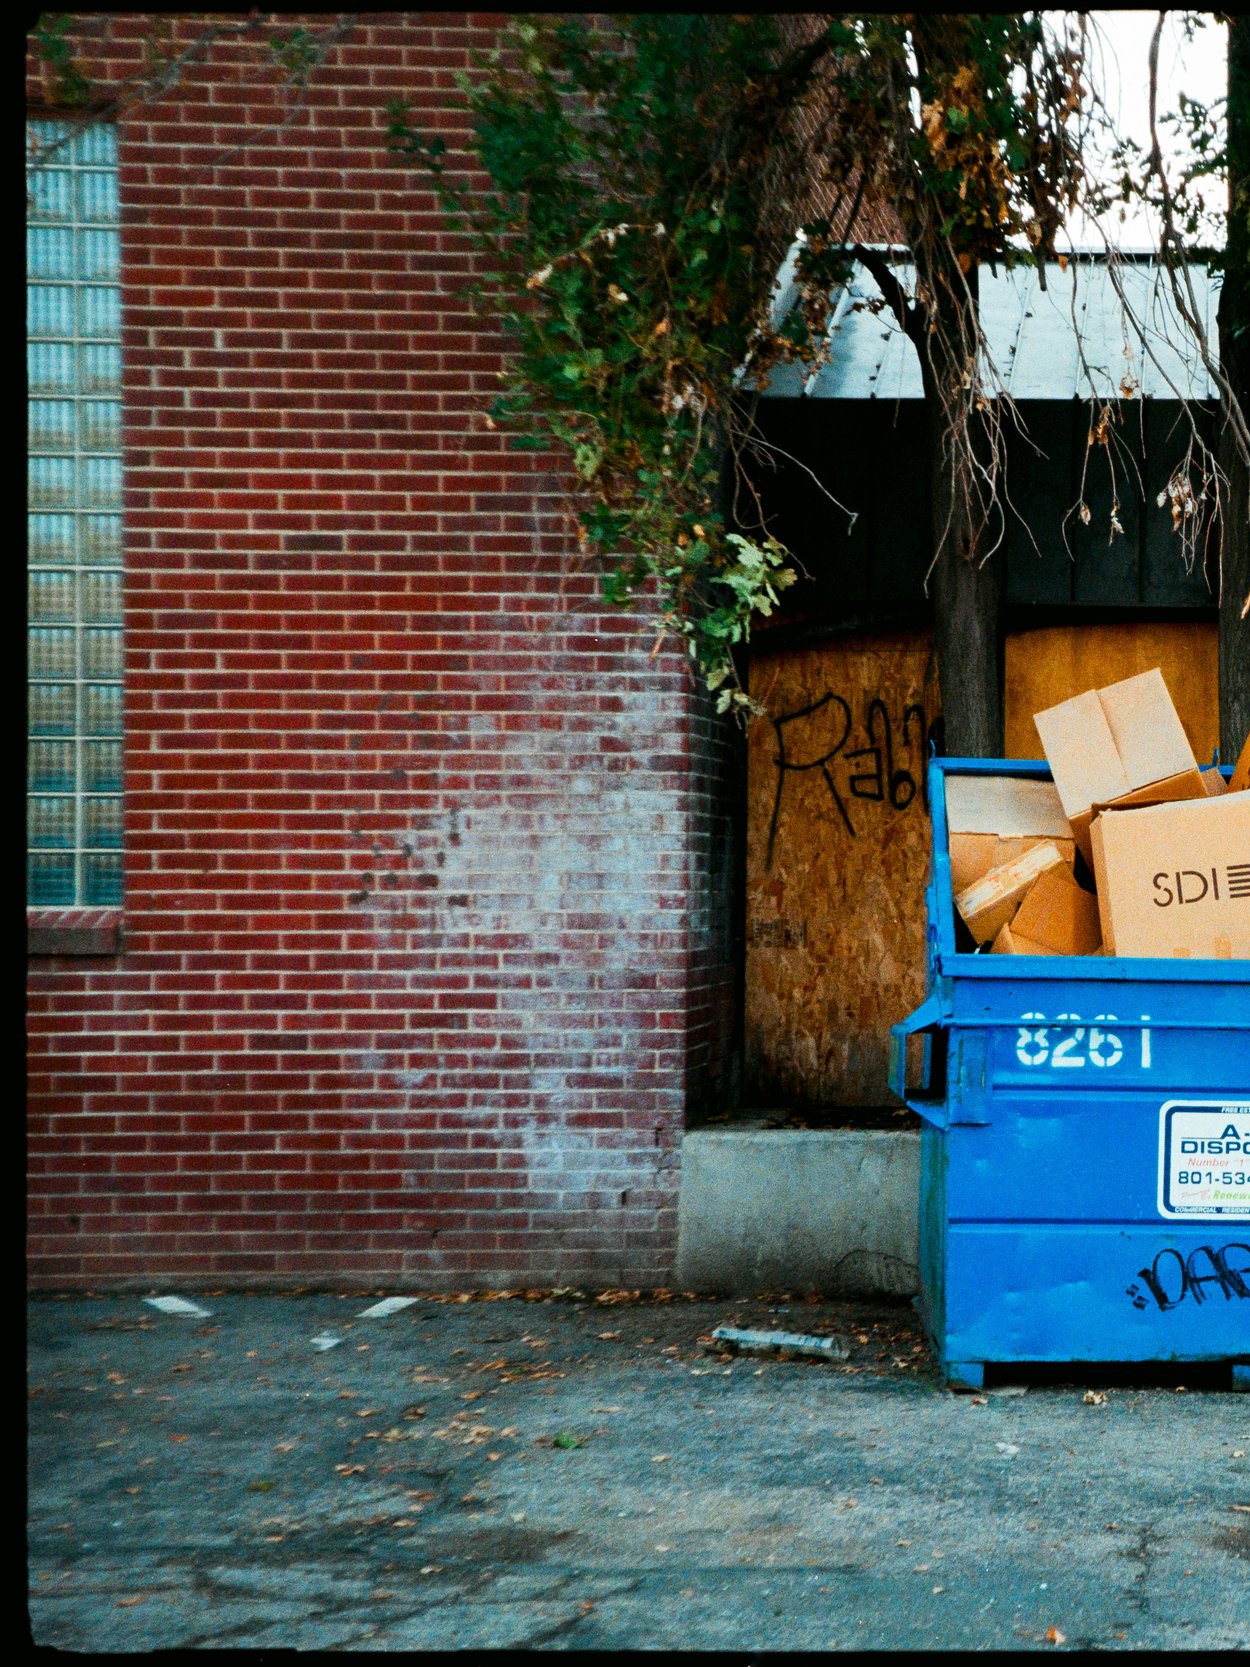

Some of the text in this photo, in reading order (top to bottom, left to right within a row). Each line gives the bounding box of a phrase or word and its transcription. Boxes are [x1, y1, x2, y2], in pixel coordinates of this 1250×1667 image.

[1152, 867, 1219, 907] SDI
[1016, 1012, 1151, 1068] 8261
[1187, 1158, 1229, 1167] Number
[1233, 1158, 1249, 1167] "1"
